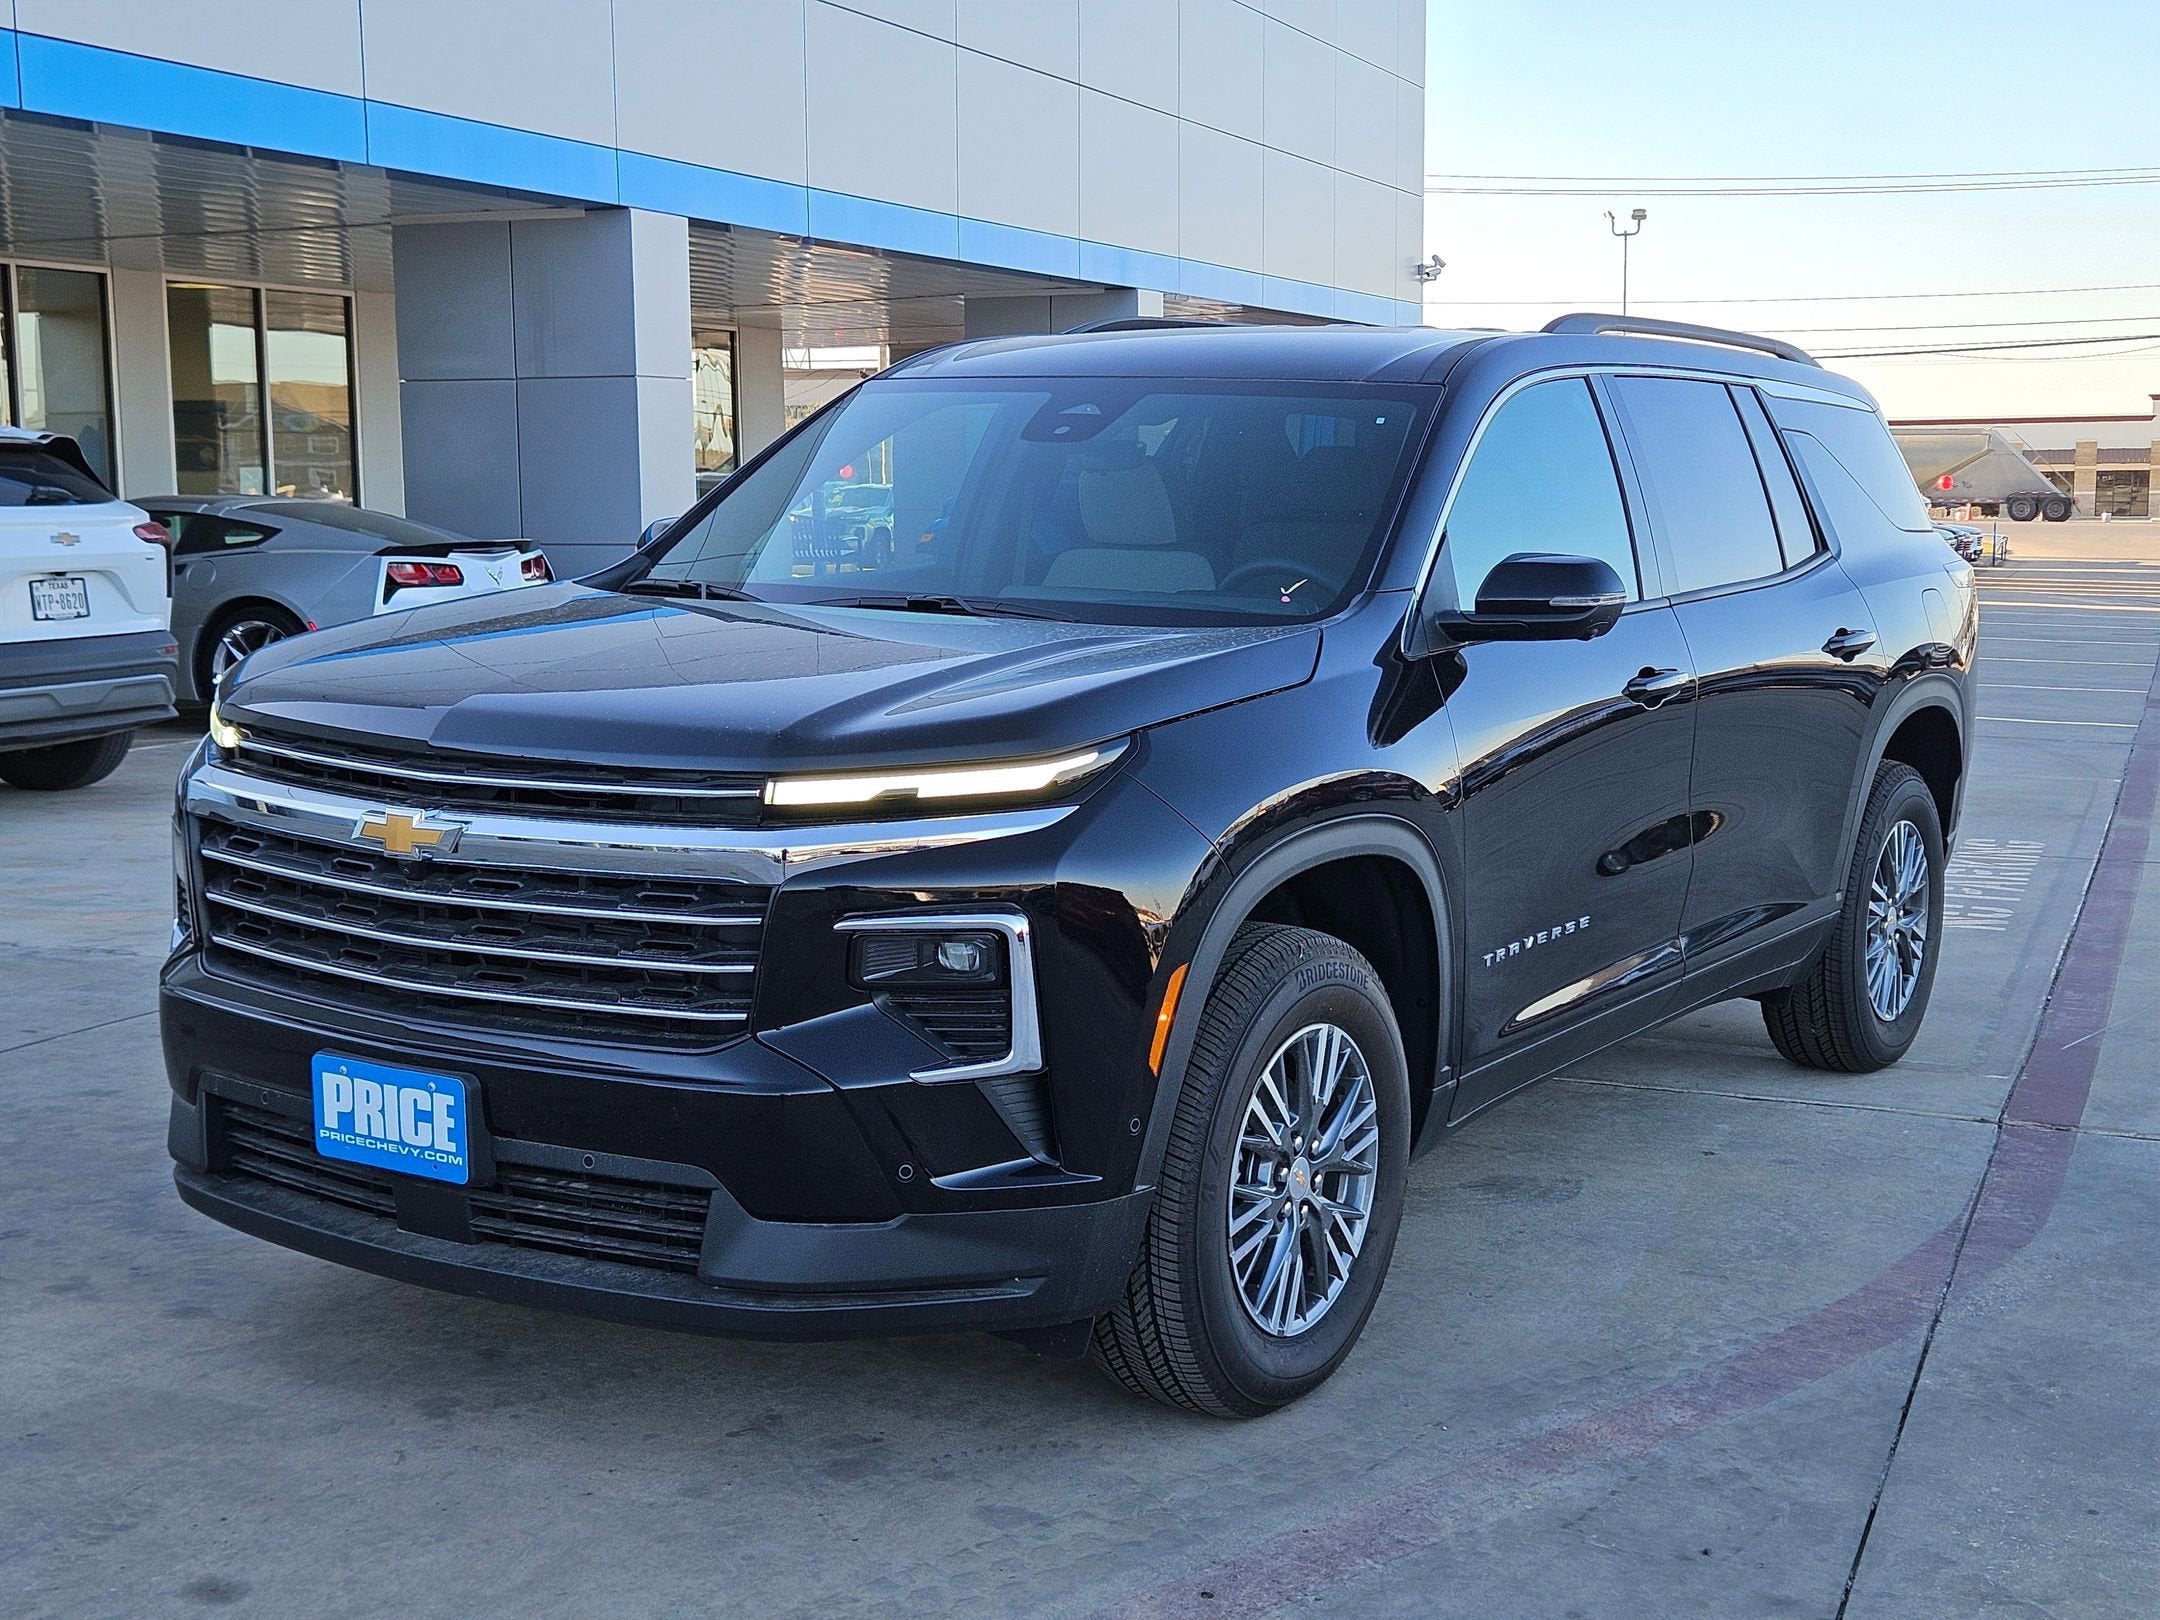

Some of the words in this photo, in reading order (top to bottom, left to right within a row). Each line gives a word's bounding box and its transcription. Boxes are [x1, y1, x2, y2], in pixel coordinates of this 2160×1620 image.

[1481, 915, 1591, 967] TRAVERSE
[1295, 962, 1369, 993] BRIDGESTONE
[321, 1071, 457, 1153] PRICE
[319, 1128, 463, 1167] PRICECHEVY.COM
